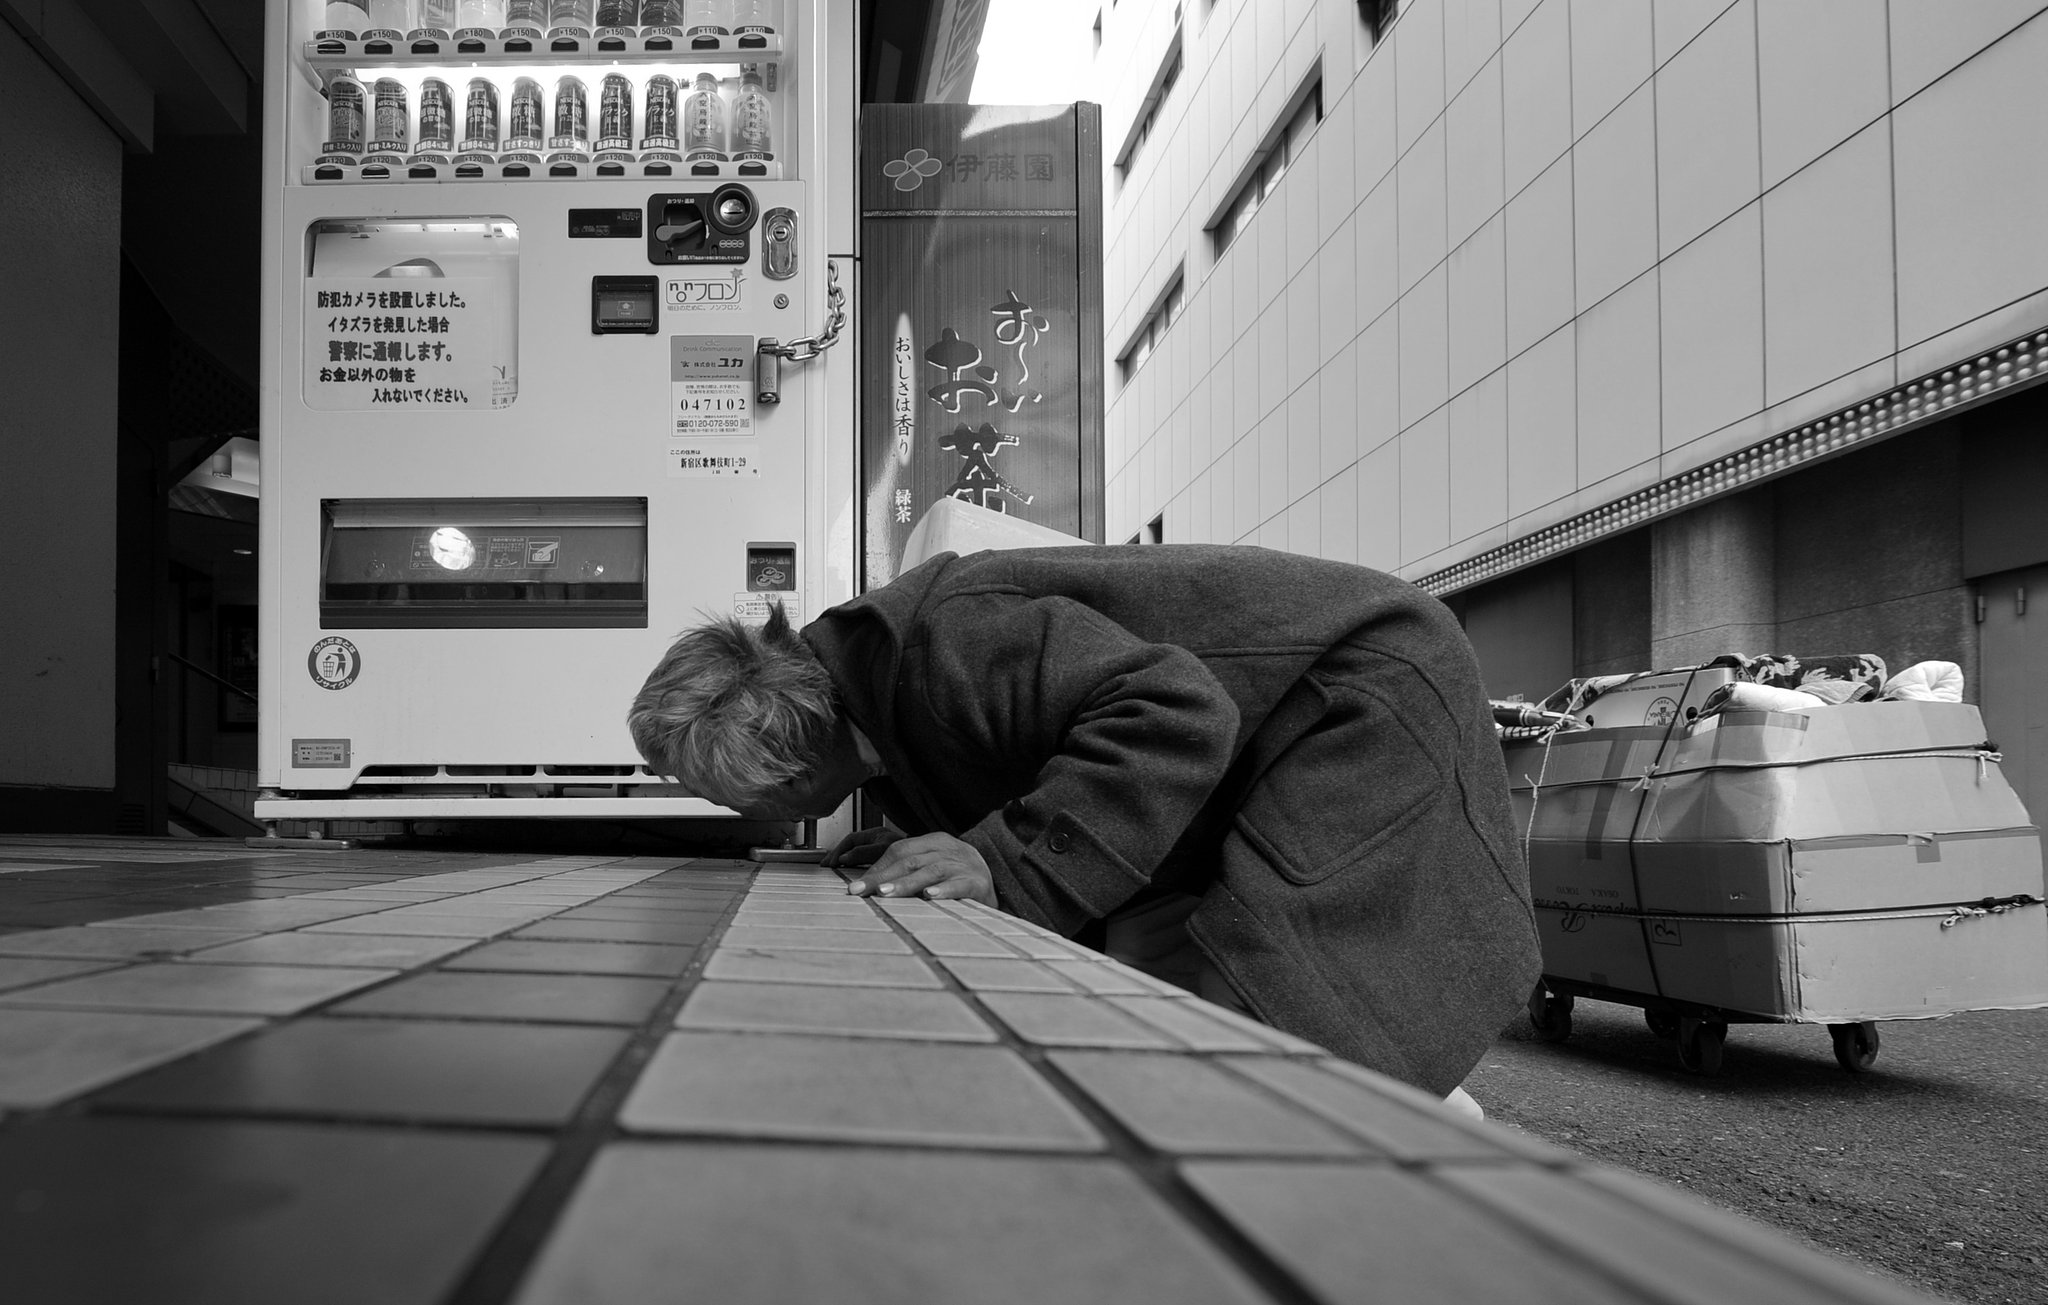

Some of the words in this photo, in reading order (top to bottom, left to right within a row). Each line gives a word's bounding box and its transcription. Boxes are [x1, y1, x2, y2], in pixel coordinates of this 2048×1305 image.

[946, 152, 1054, 183] 伊藤園
[318, 291, 466, 308] 防犯カメラを設置しました。
[328, 316, 450, 334] イタズラを発見した場合
[328, 341, 453, 362] 警察に通報します。
[319, 367, 416, 383] お金以外の物を
[372, 388, 468, 403] 入れないでください。
[893, 336, 915, 456] おいしさは香り
[680, 398, 746, 411] 047102
[689, 420, 739, 428] 0120-072-590
[895, 489, 912, 523] 緑茶
[314, 637, 356, 653] のんだあとは
[315, 675, 352, 689] リサイクル
